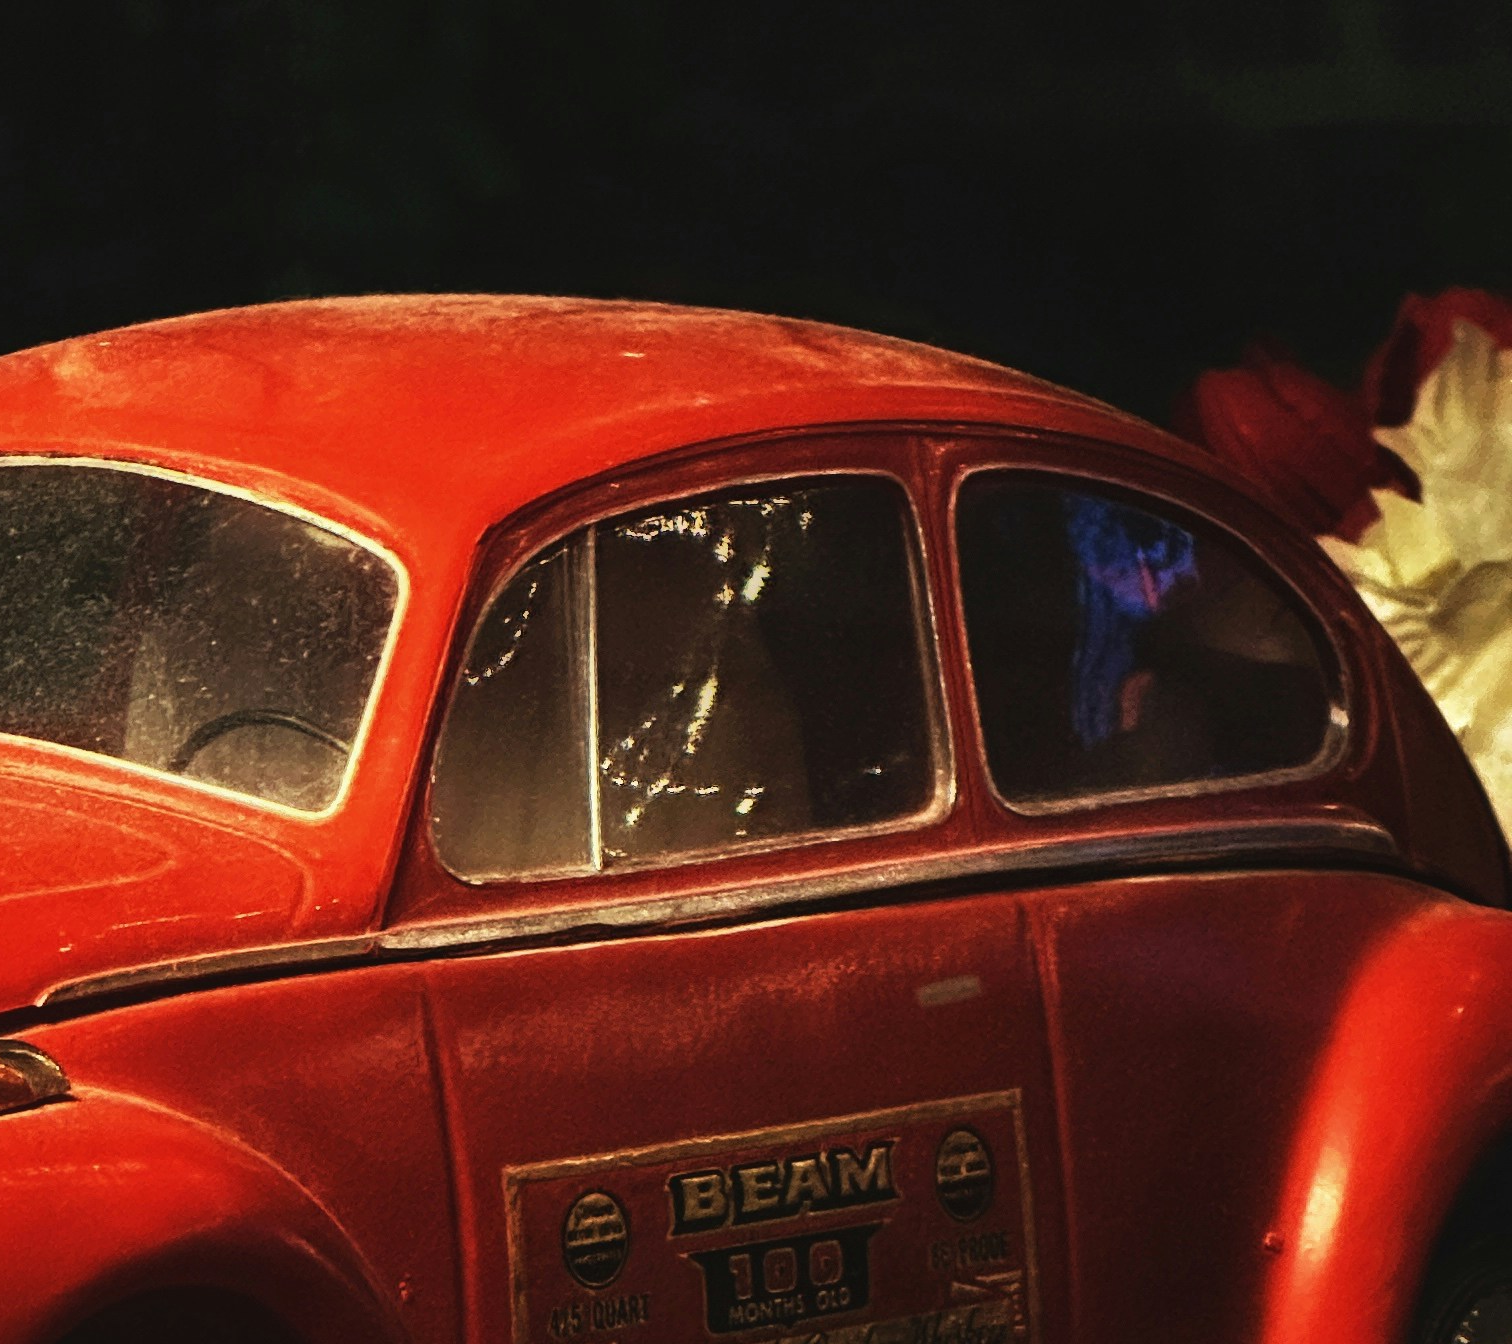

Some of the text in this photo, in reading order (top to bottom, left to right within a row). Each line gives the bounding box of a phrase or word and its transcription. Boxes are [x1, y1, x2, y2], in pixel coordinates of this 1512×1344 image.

[676, 1145, 896, 1224] BEAM
[729, 1239, 846, 1300] 100
[592, 1294, 651, 1330] QUART
[727, 1285, 852, 1328] MONTHS OLD
